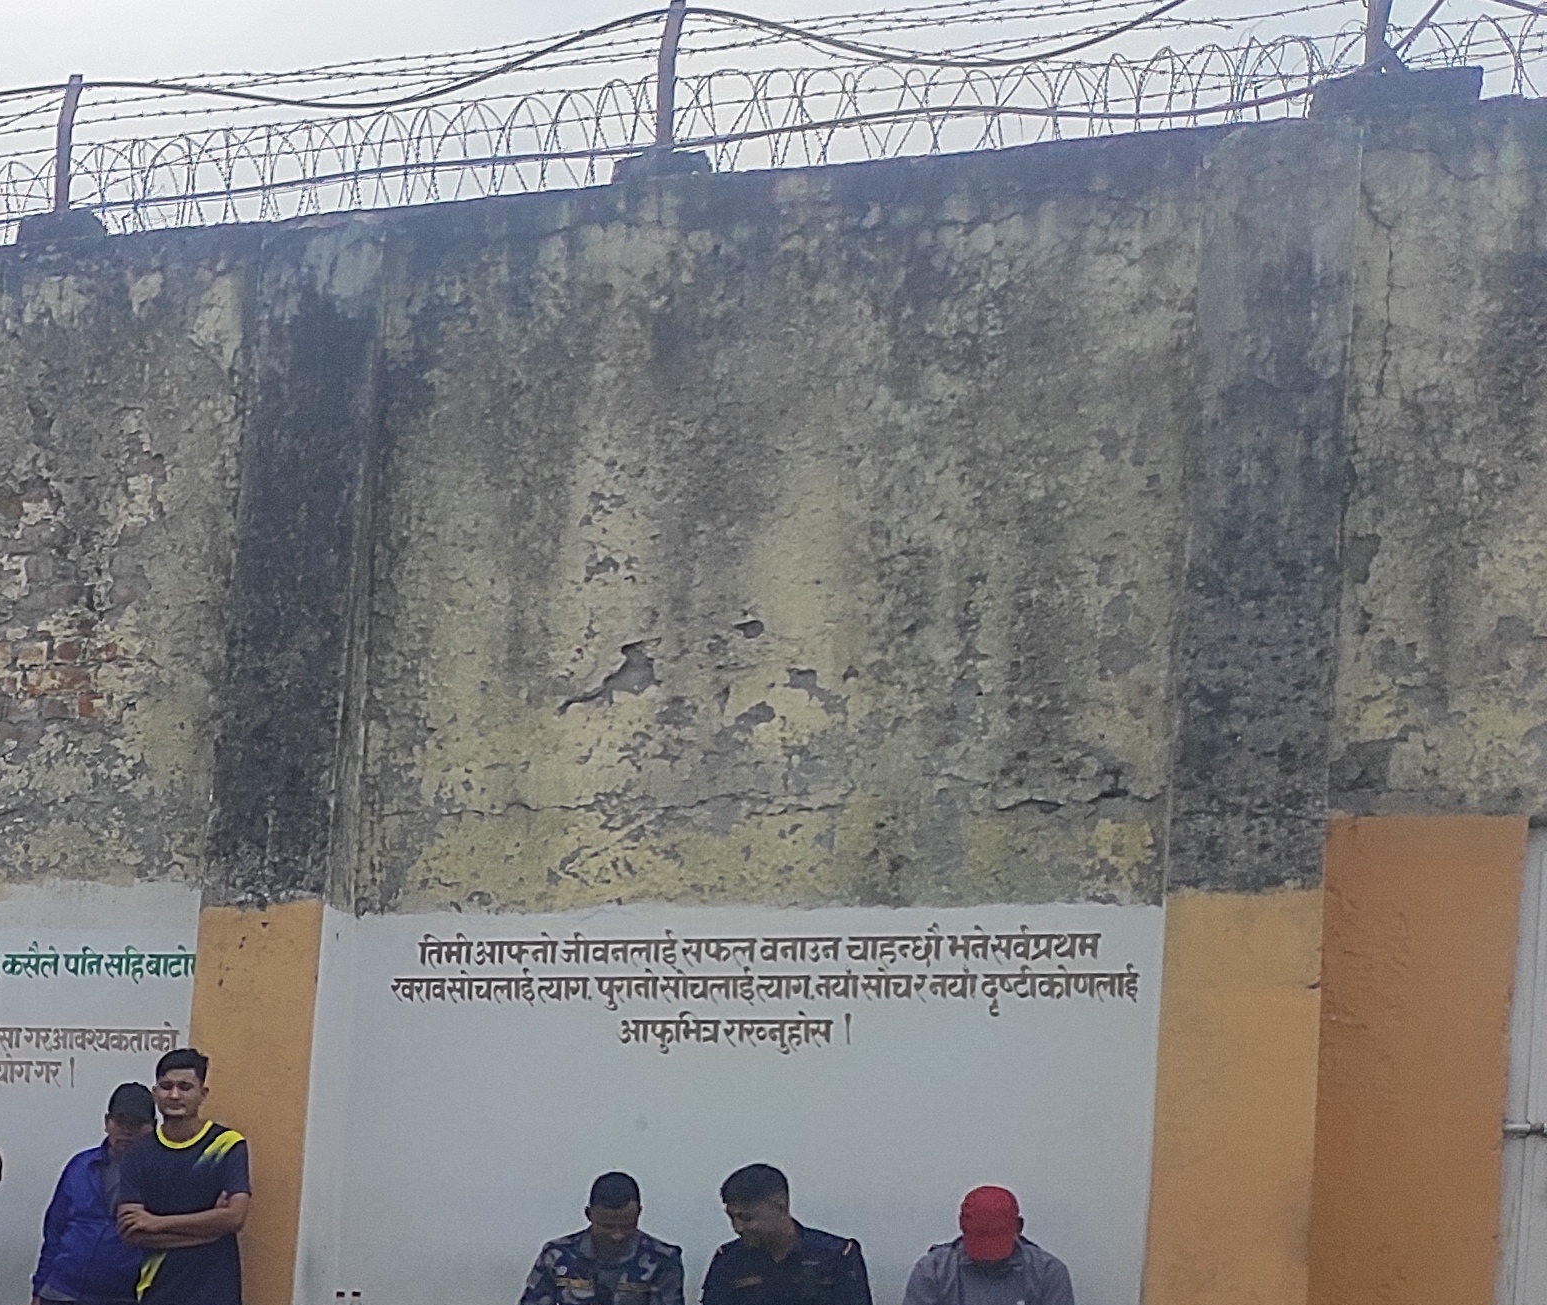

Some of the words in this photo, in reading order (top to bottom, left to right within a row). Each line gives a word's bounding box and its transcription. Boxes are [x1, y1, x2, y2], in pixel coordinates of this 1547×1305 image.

[2, 941, 59, 977] कसैले
[63, 946, 104, 976] पनि
[418, 932, 473, 970] तिमी
[560, 931, 679, 969] जीवनलाई
[681, 938, 757, 967] सफल
[760, 937, 842, 962] बनाउन
[447, 969, 535, 1007] सोचलाई
[659, 968, 754, 1006] सोचलाई
